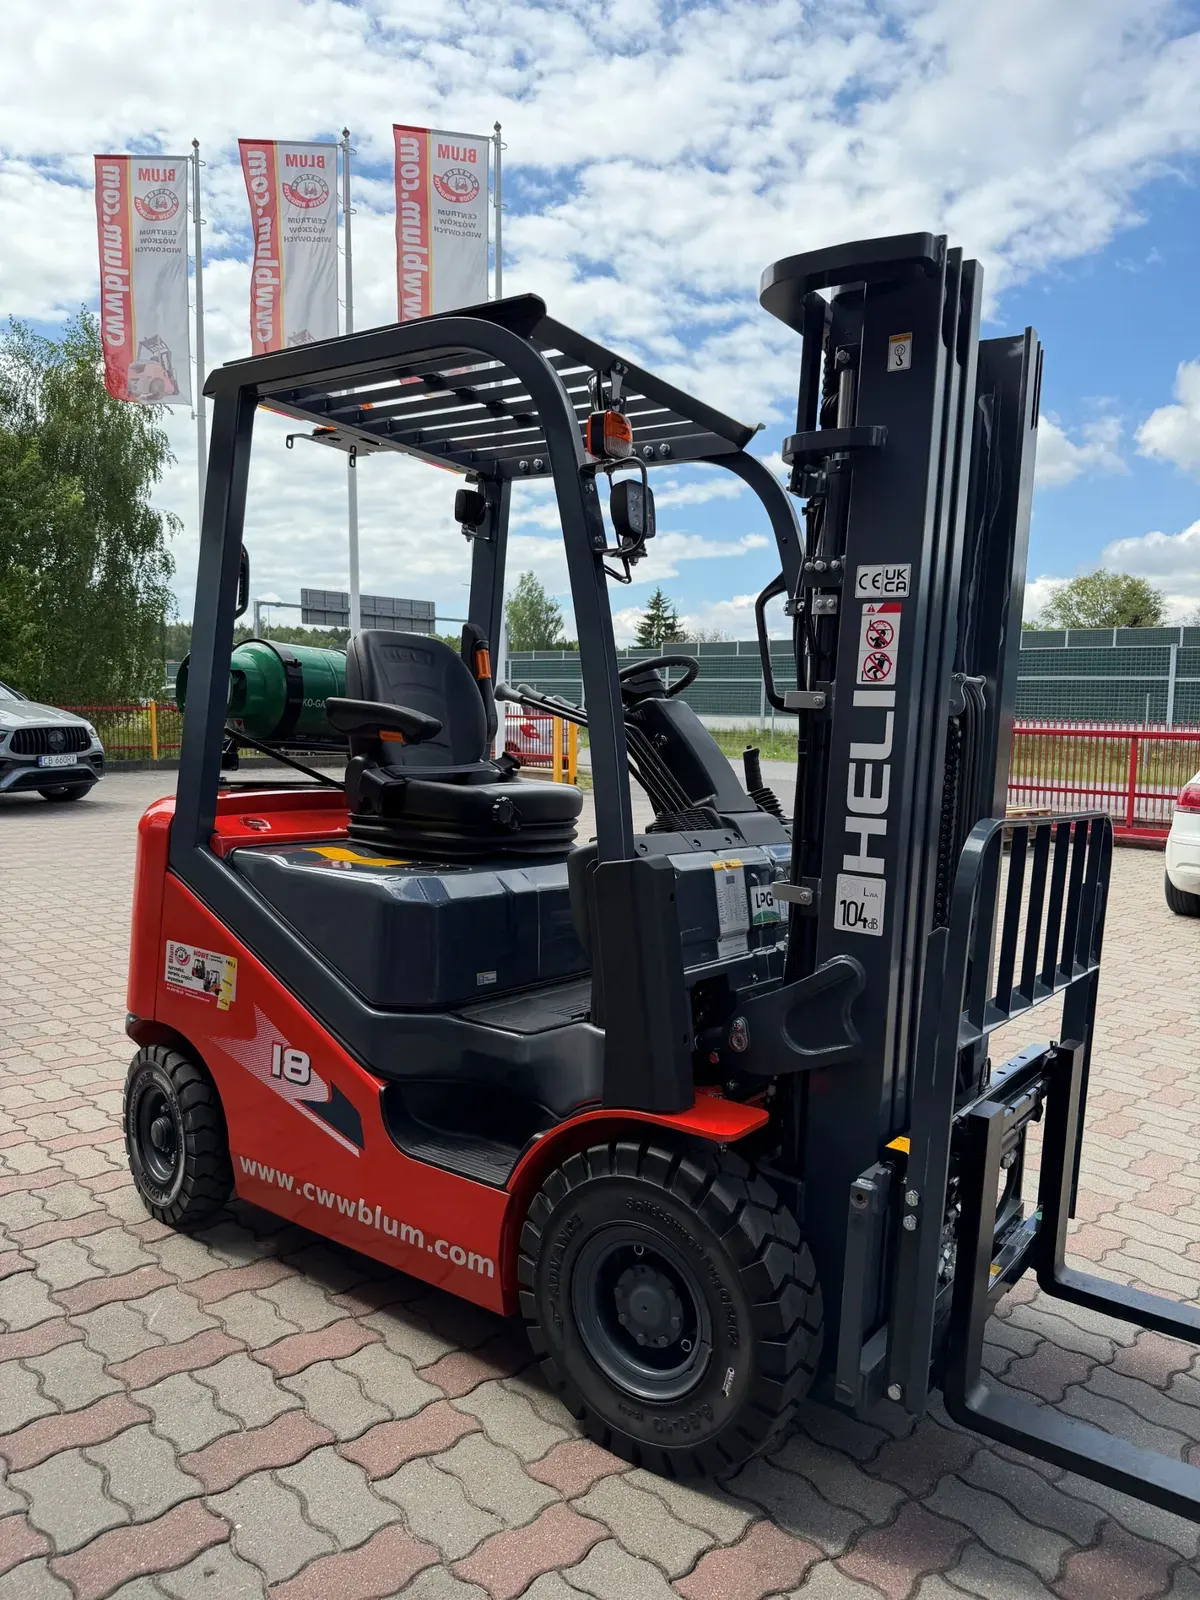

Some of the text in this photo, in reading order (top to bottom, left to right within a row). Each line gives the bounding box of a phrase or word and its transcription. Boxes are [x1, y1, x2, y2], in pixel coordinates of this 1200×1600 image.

[885, 568, 907, 580] UK
[884, 581, 907, 592] CA
[302, 698, 326, 709] KO-GA
[44, 756, 52, 764] CB
[842, 690, 896, 875] HELI
[756, 892, 774, 908] LPG
[840, 900, 878, 930] 104 dB
[270, 1042, 311, 1086] 18
[240, 1156, 494, 1279] www.cwwblum.com
